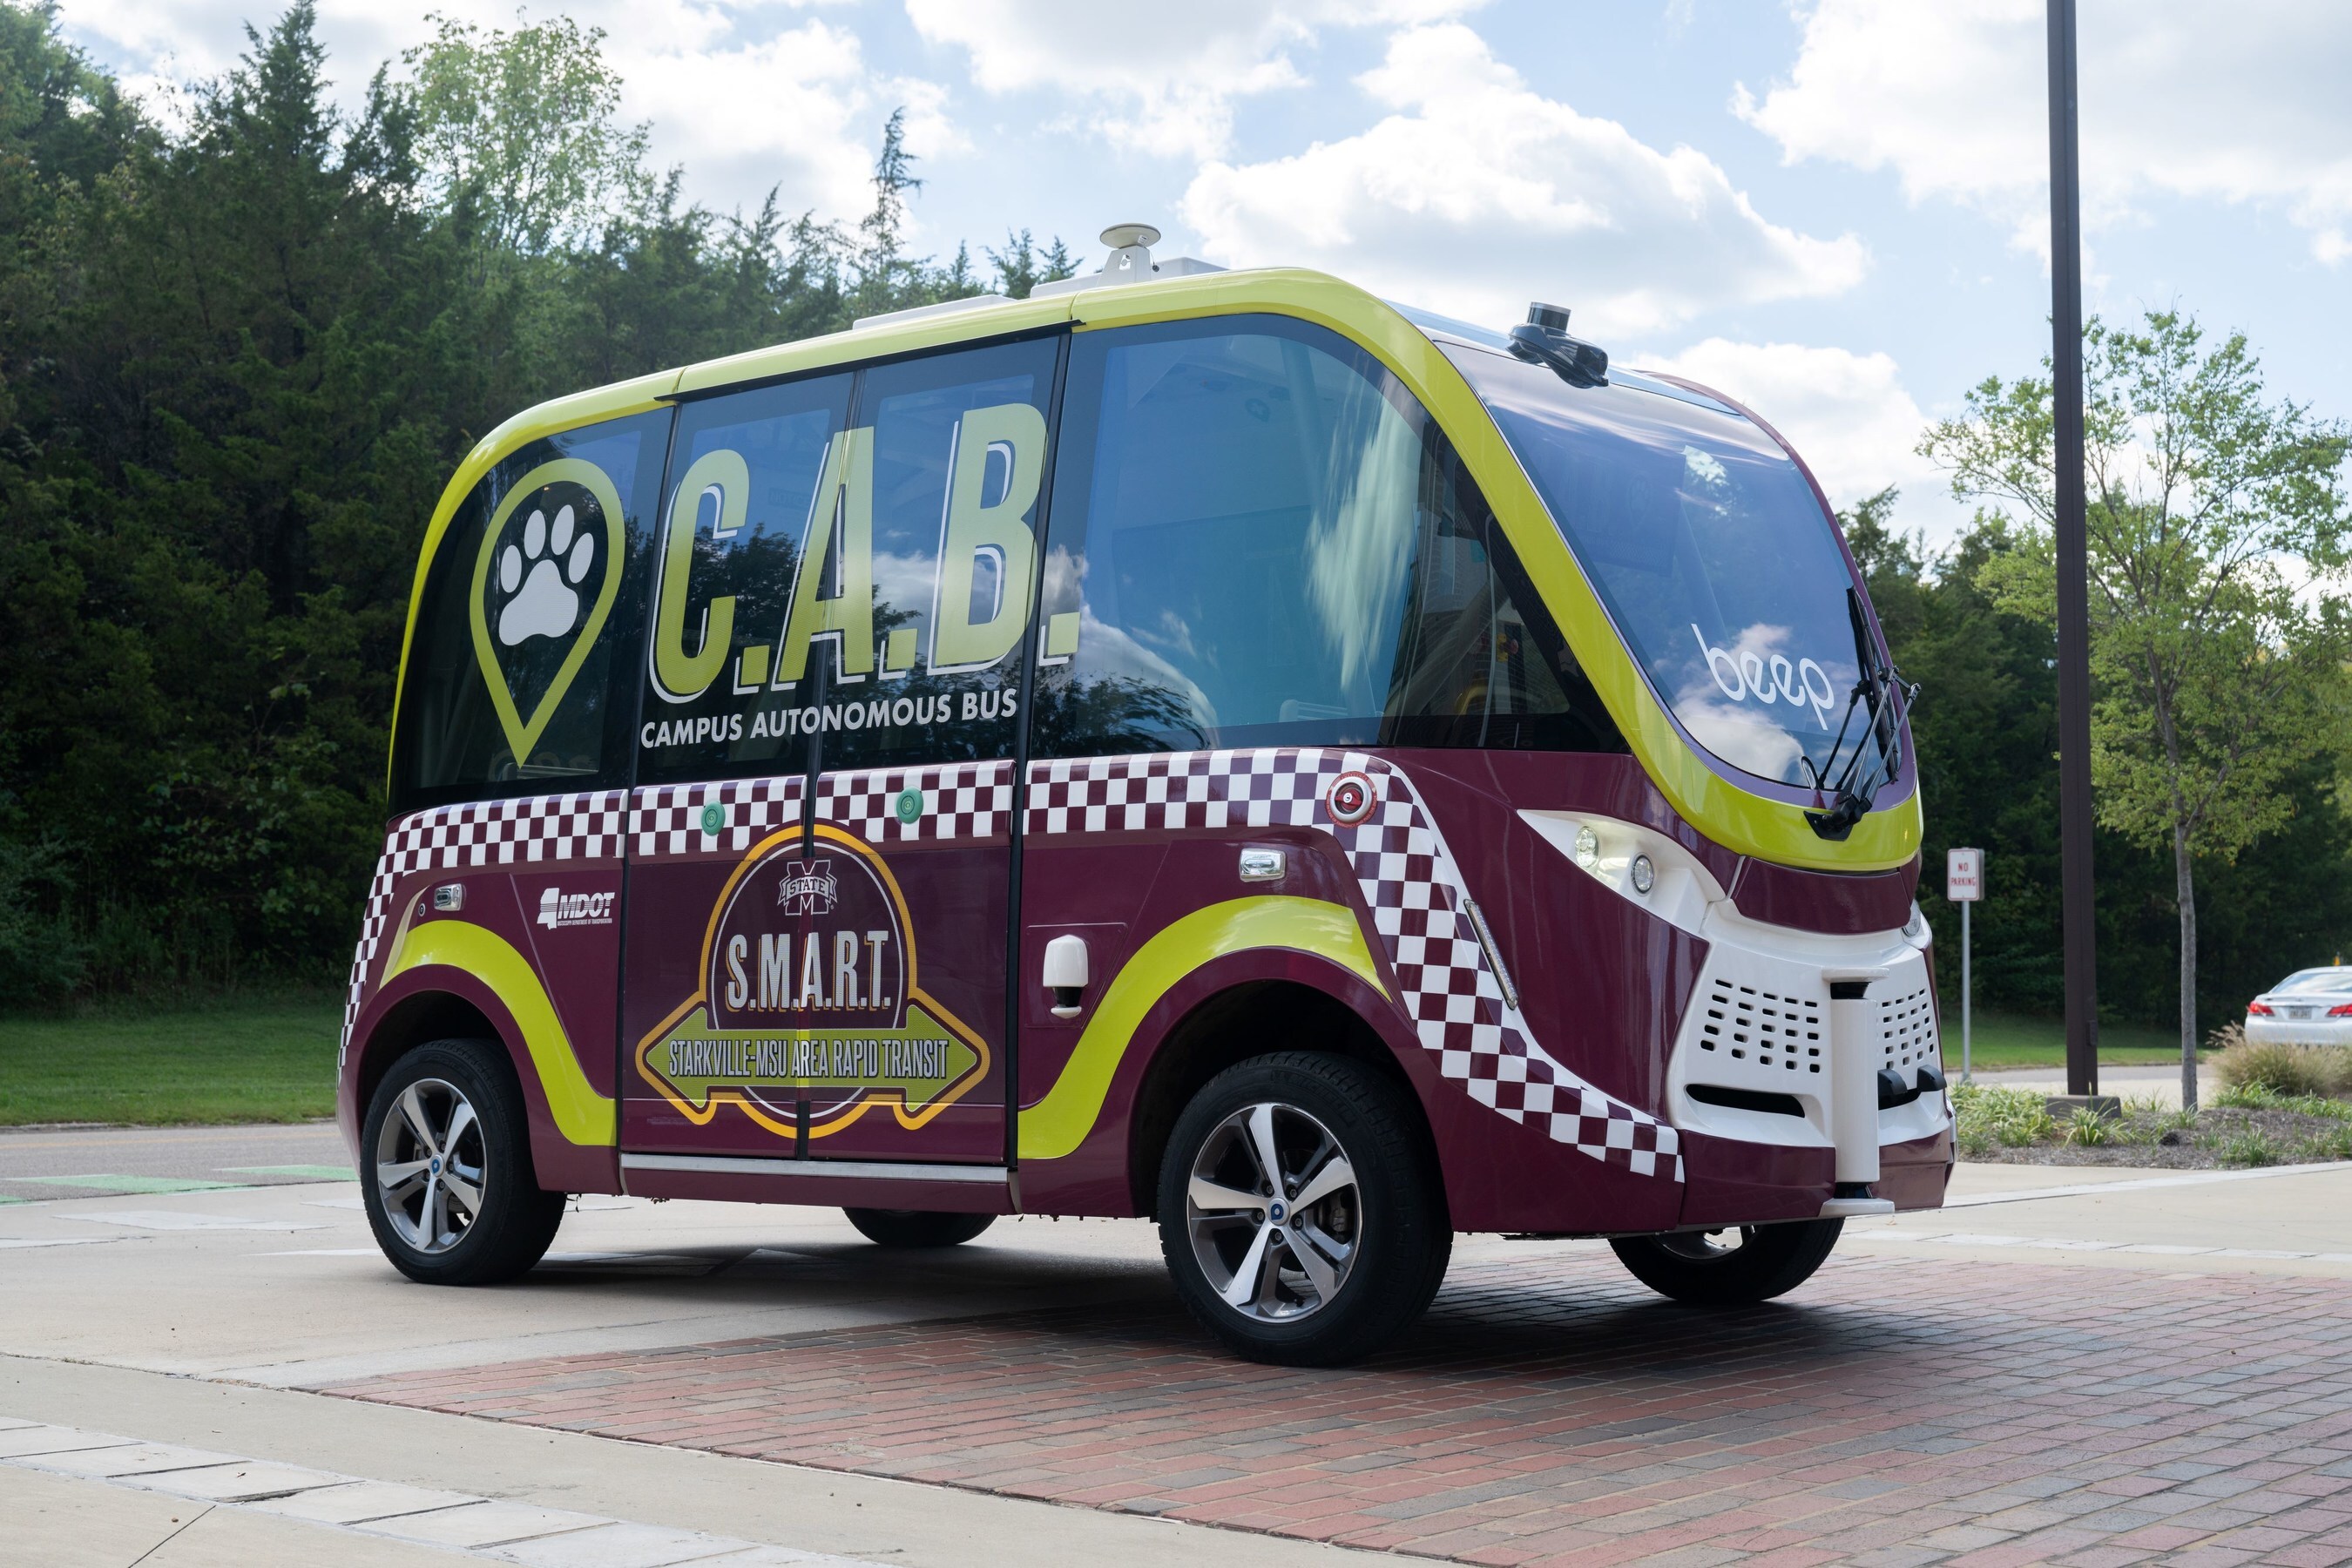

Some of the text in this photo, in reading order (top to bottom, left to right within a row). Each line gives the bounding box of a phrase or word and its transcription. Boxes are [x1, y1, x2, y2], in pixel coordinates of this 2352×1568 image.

[649, 402, 1080, 703] C.A.B.
[1691, 623, 1835, 731] beep
[640, 688, 1017, 748] CAMPUS AUTONOMOUS BUS
[789, 878, 826, 896] STATE
[1951, 876, 1976, 887] PARKING
[1957, 862, 1969, 872] NO
[558, 892, 615, 919] MDOT
[726, 929, 891, 1010] S.M.A.R.T.
[668, 1039, 950, 1079] STARKVILLE-MSU AREA RAPID TRANSIT
